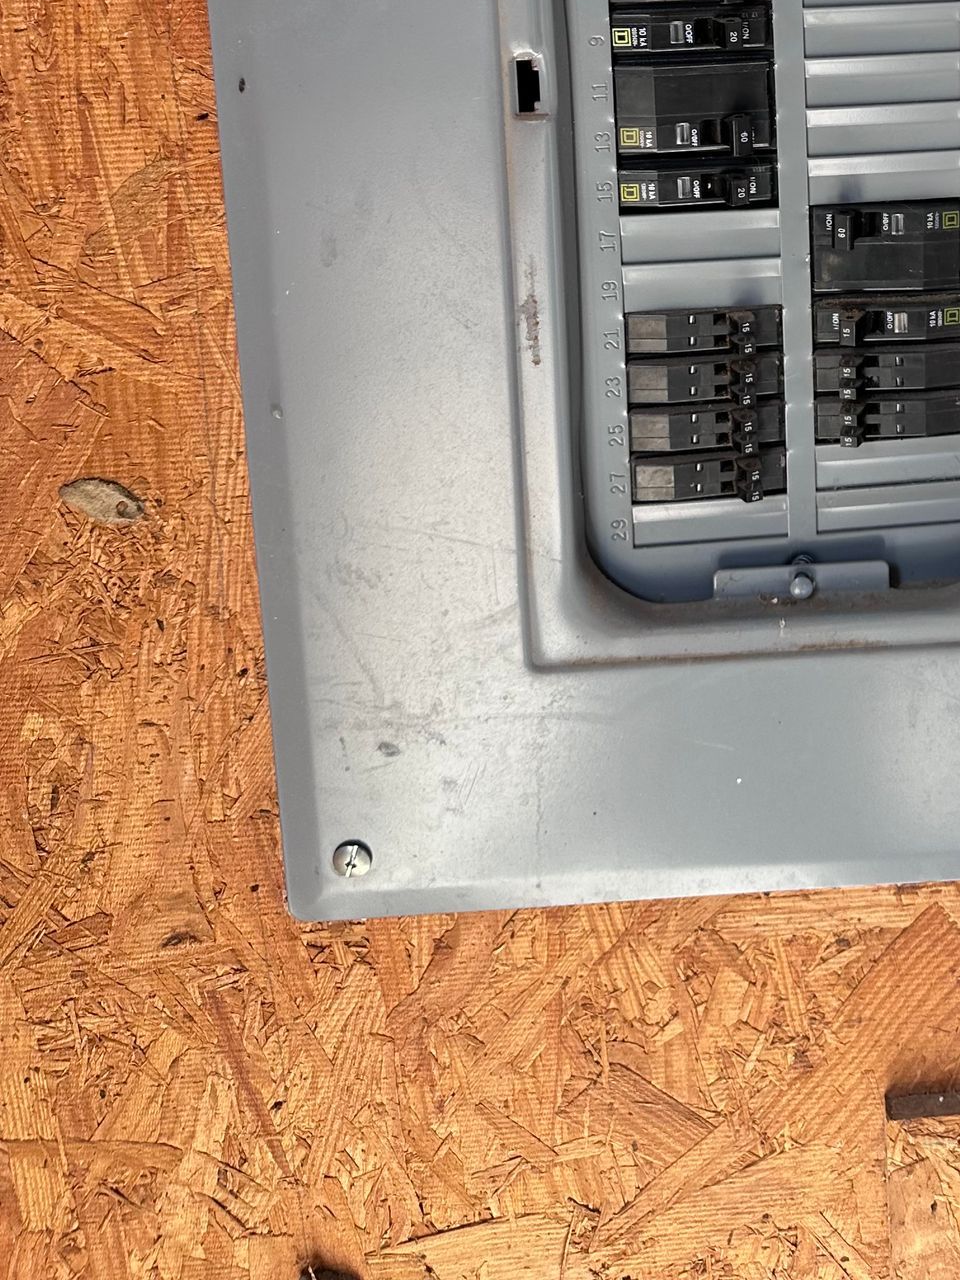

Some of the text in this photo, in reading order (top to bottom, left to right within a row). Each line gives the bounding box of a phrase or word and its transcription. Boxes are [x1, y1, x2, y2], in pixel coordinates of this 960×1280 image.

[588, 35, 604, 46] 9
[639, 28, 647, 46] 10 kA
[730, 31, 737, 42] 20
[591, 81, 608, 102] 11
[594, 131, 611, 152] 13
[741, 132, 748, 142] 60
[596, 181, 613, 202] 15
[738, 188, 745, 198] 20
[838, 228, 845, 238] 60
[599, 231, 616, 252] 17
[602, 281, 618, 301] 19
[930, 311, 936, 319] kA
[742, 323, 749, 332] 15
[843, 329, 850, 337] 15
[604, 329, 620, 350] 21
[745, 344, 752, 353] 15
[745, 373, 753, 382] 15
[843, 368, 850, 377] 15
[606, 376, 621, 398] 23
[844, 390, 851, 398] 15
[743, 395, 750, 404] 15
[845, 416, 851, 424] 15
[744, 422, 752, 431] 15
[608, 424, 624, 446] 25
[845, 438, 852, 446] 15
[745, 444, 752, 453] 15
[752, 471, 759, 480] 15
[609, 473, 626, 494] 27
[752, 491, 759, 501] 15
[611, 520, 627, 541] 29
